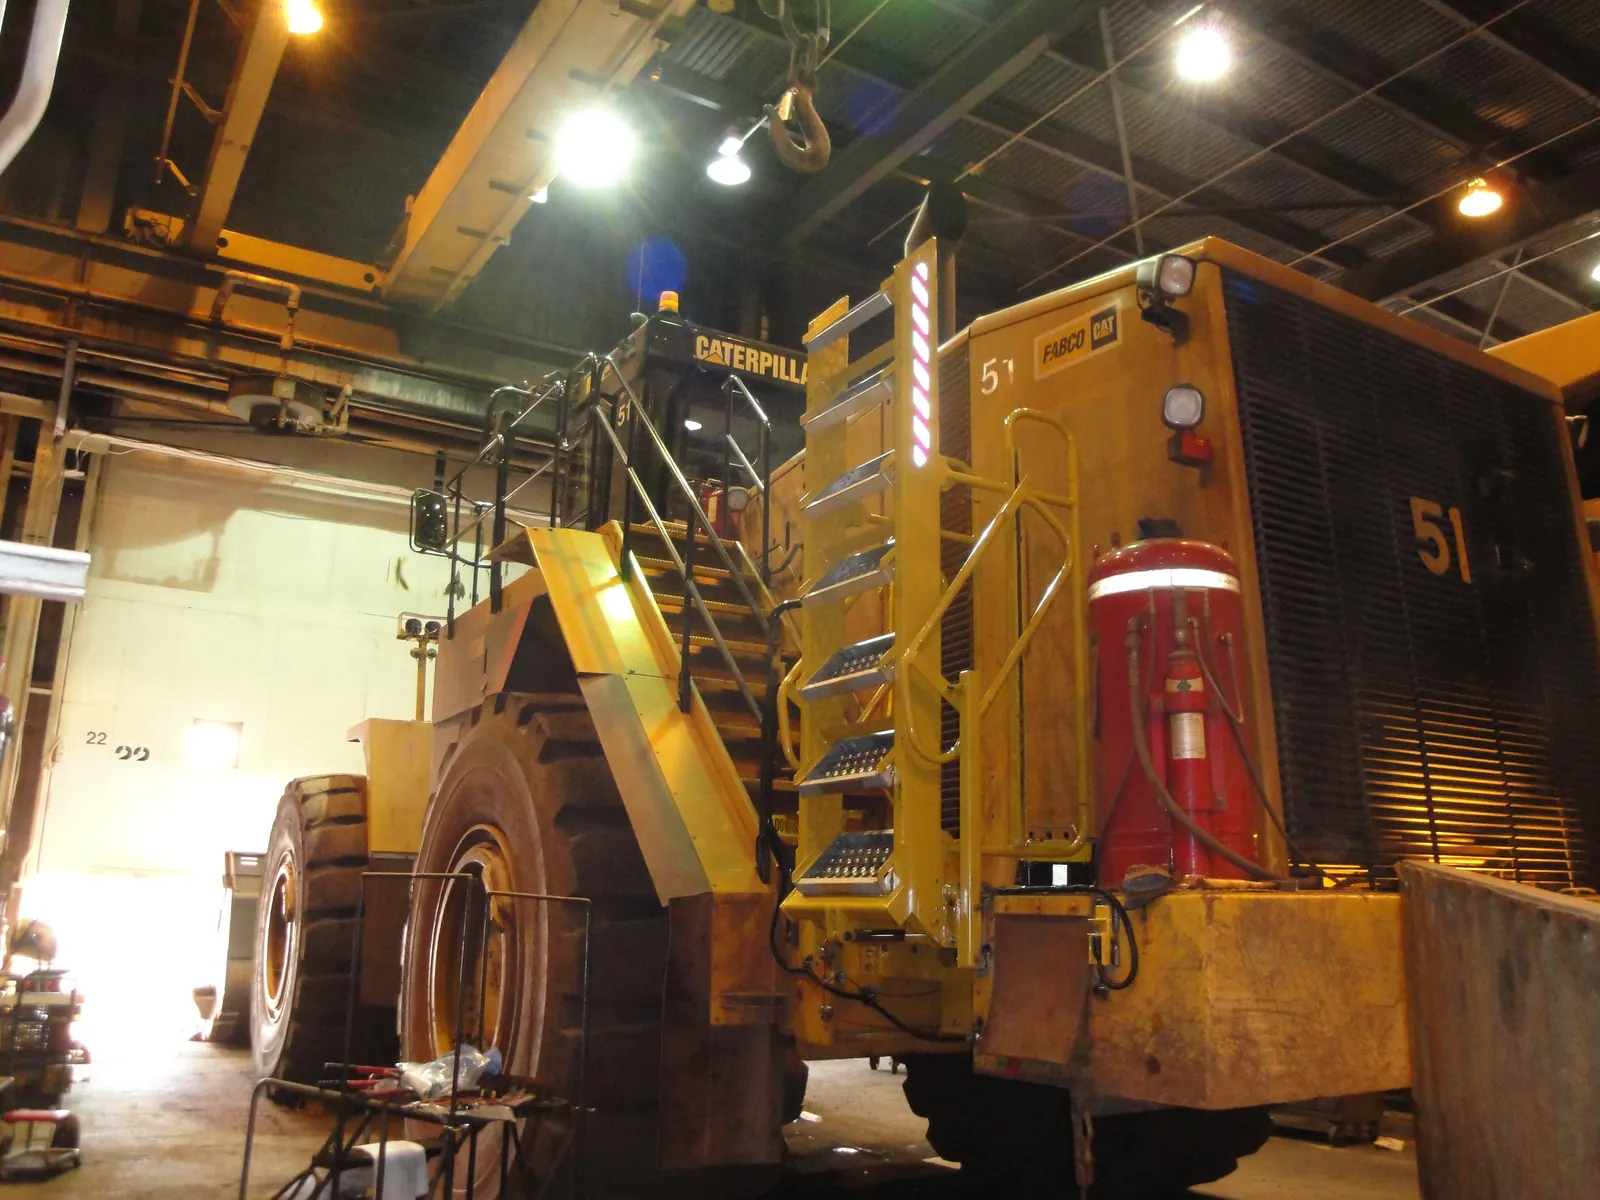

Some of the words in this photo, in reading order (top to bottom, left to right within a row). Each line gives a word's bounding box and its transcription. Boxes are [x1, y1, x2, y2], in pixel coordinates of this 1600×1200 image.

[1043, 328, 1086, 364] FABCO
[1092, 315, 1116, 341] CAT
[981, 357, 1014, 395] 51
[617, 399, 631, 427] 51
[1409, 496, 1471, 584] 51
[85, 731, 108, 746] 22
